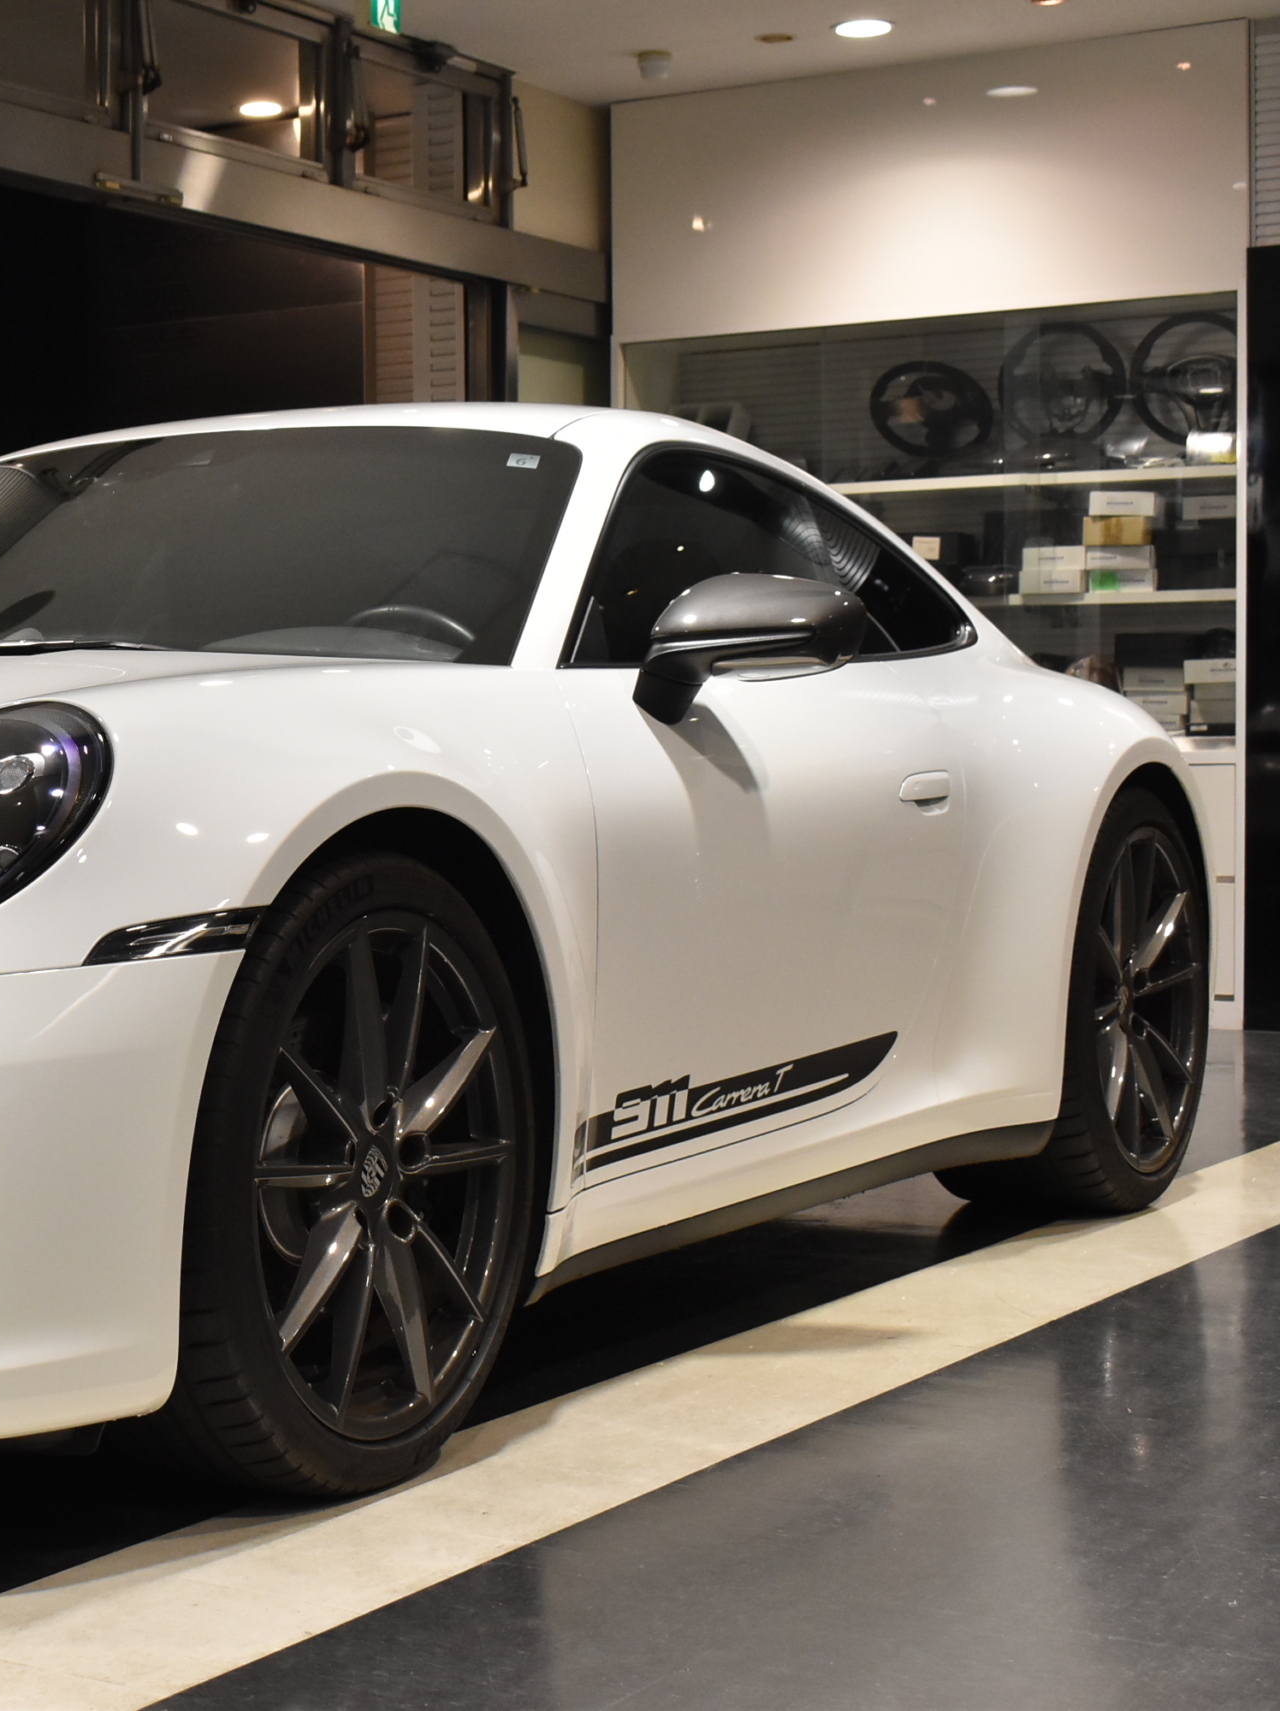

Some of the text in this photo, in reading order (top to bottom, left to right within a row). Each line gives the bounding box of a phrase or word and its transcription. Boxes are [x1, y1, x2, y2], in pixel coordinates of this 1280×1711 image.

[611, 1063, 794, 1140] 911 Carrera T
